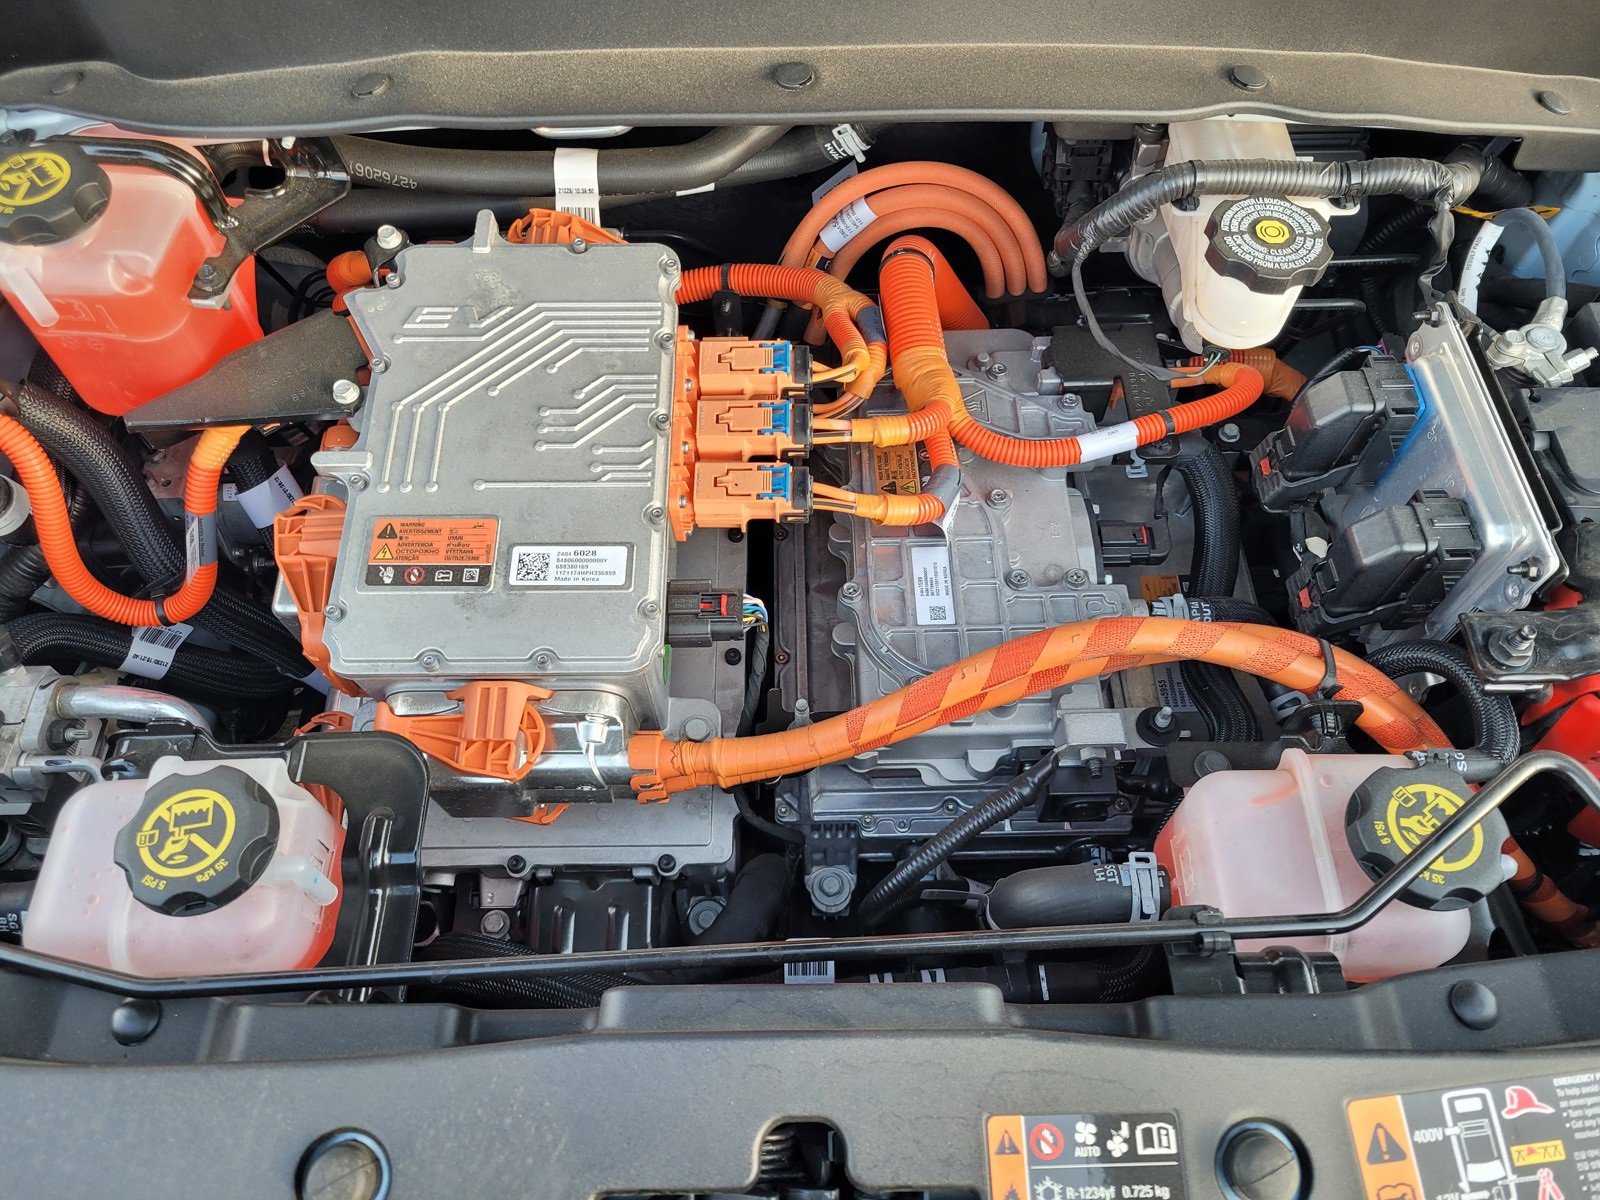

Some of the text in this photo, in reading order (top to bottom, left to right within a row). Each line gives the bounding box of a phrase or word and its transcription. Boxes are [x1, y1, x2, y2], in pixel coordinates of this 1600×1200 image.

[1234, 248, 1254, 262] FLUID
[1252, 258, 1274, 268] FROM
[1279, 258, 1306, 269] SEALED
[1269, 246, 1292, 254] CLEAN
[1200, 602, 1212, 622] OUT
[1374, 821, 1391, 845] 5 PSI
[195, 858, 228, 883] 35 kPa
[1094, 868, 1106, 882] LH
[1104, 865, 1119, 885] SGT
[142, 874, 167, 890] 5 PSI
[1413, 1126, 1444, 1144] 400V
[1074, 1146, 1101, 1158] AUTO
[1066, 1184, 1170, 1200] R-1234yf 0.725 kg
